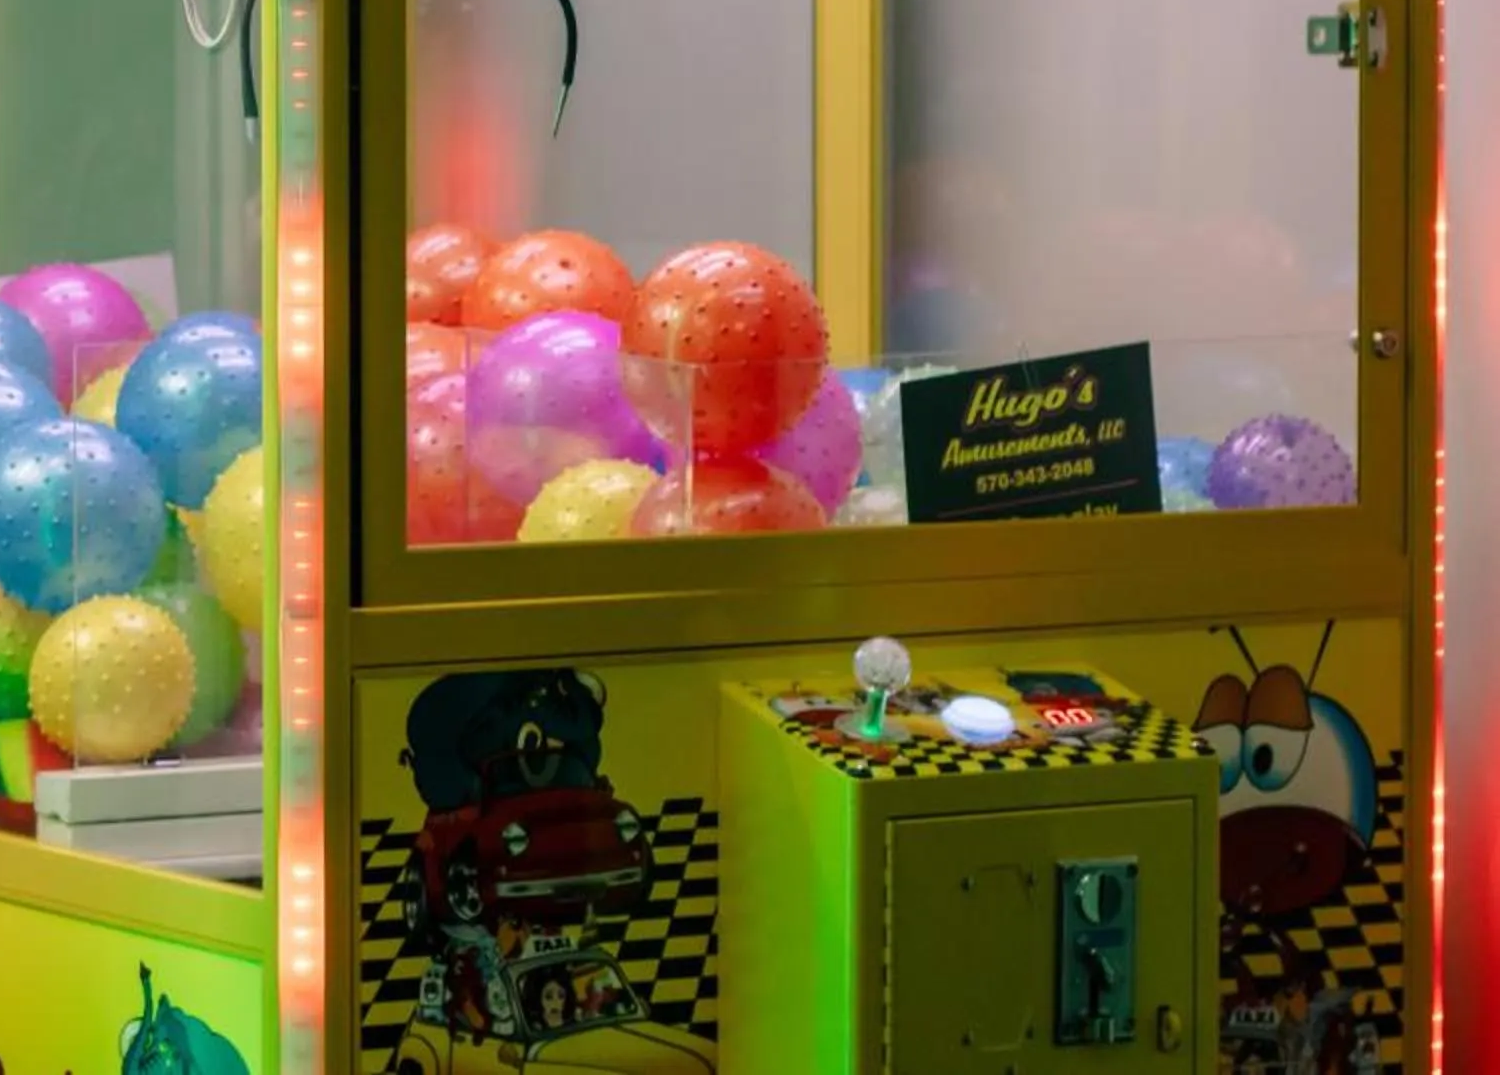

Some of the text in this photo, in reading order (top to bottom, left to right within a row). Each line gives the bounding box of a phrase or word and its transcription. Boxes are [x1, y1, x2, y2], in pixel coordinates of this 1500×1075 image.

[965, 367, 1095, 426] Hugo's
[941, 422, 1091, 470] Amusements,
[976, 457, 1095, 494] 570-343-2048
